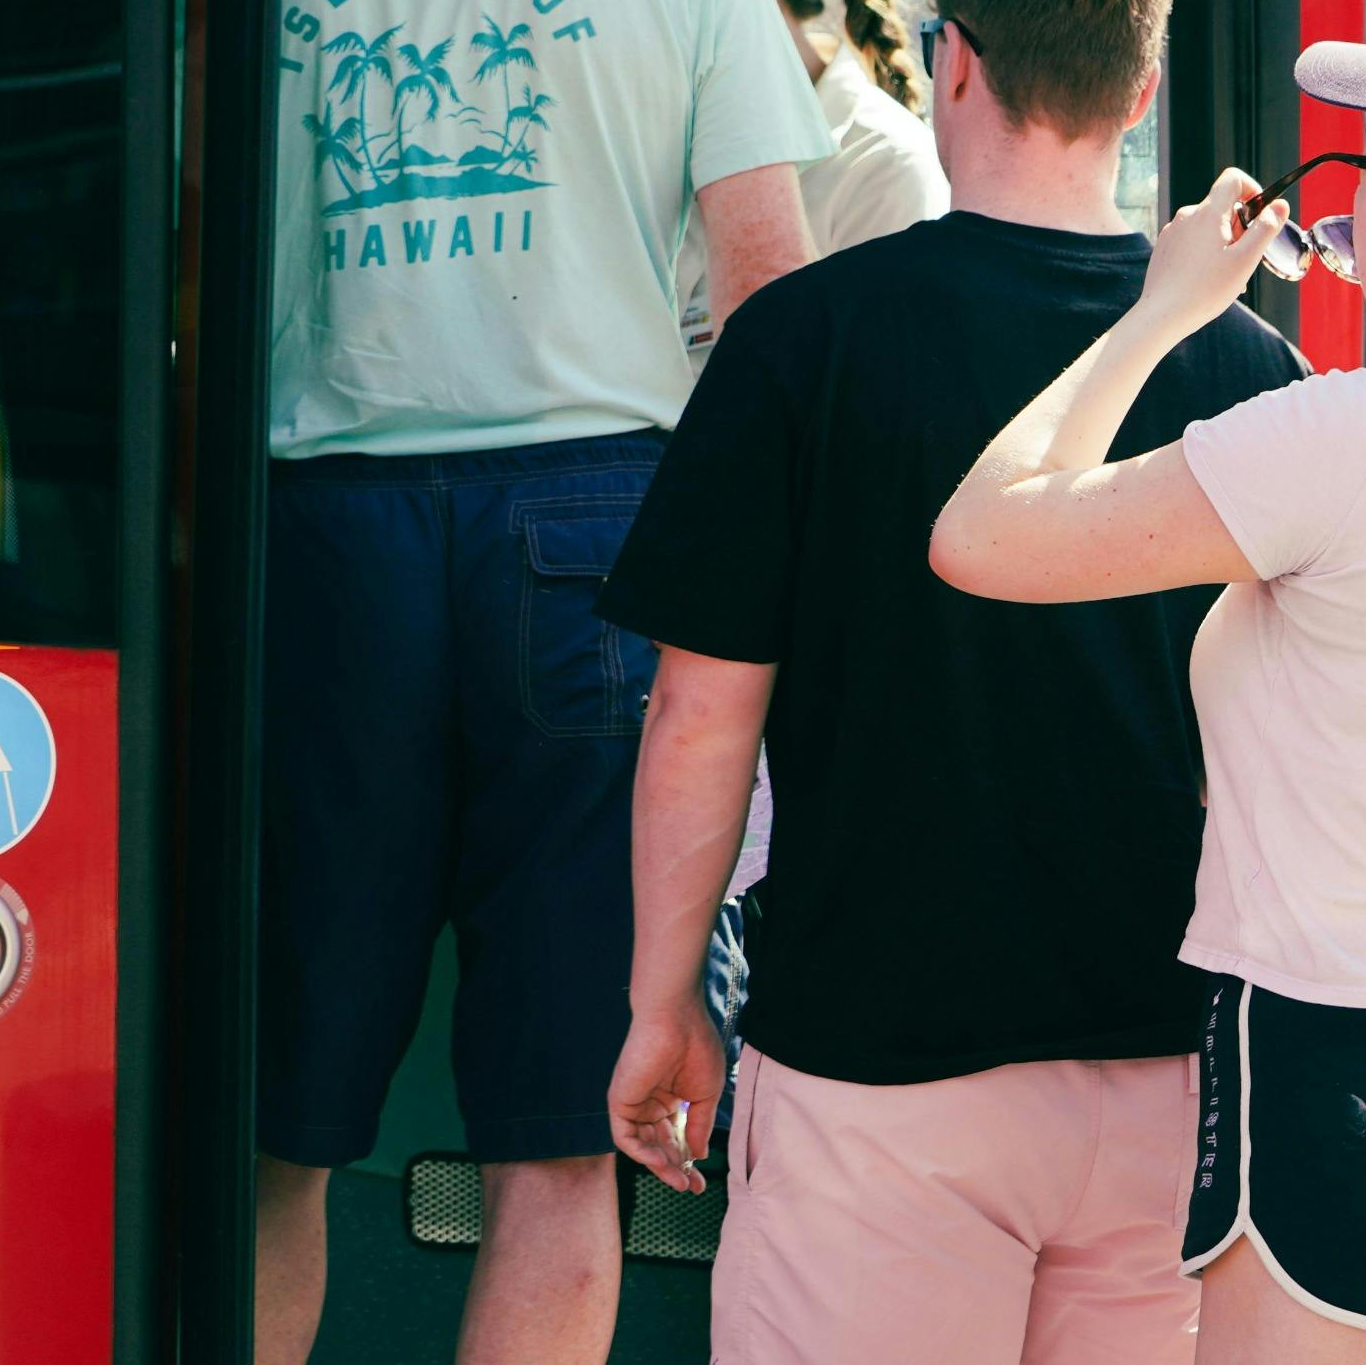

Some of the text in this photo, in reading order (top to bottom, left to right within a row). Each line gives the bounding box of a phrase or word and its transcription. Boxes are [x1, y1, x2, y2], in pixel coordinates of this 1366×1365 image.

[322, 209, 533, 273] HAWAII
[24, 932, 35, 963] DOOR
[18, 968, 32, 985] THE
[3, 987, 23, 1009] PULL
